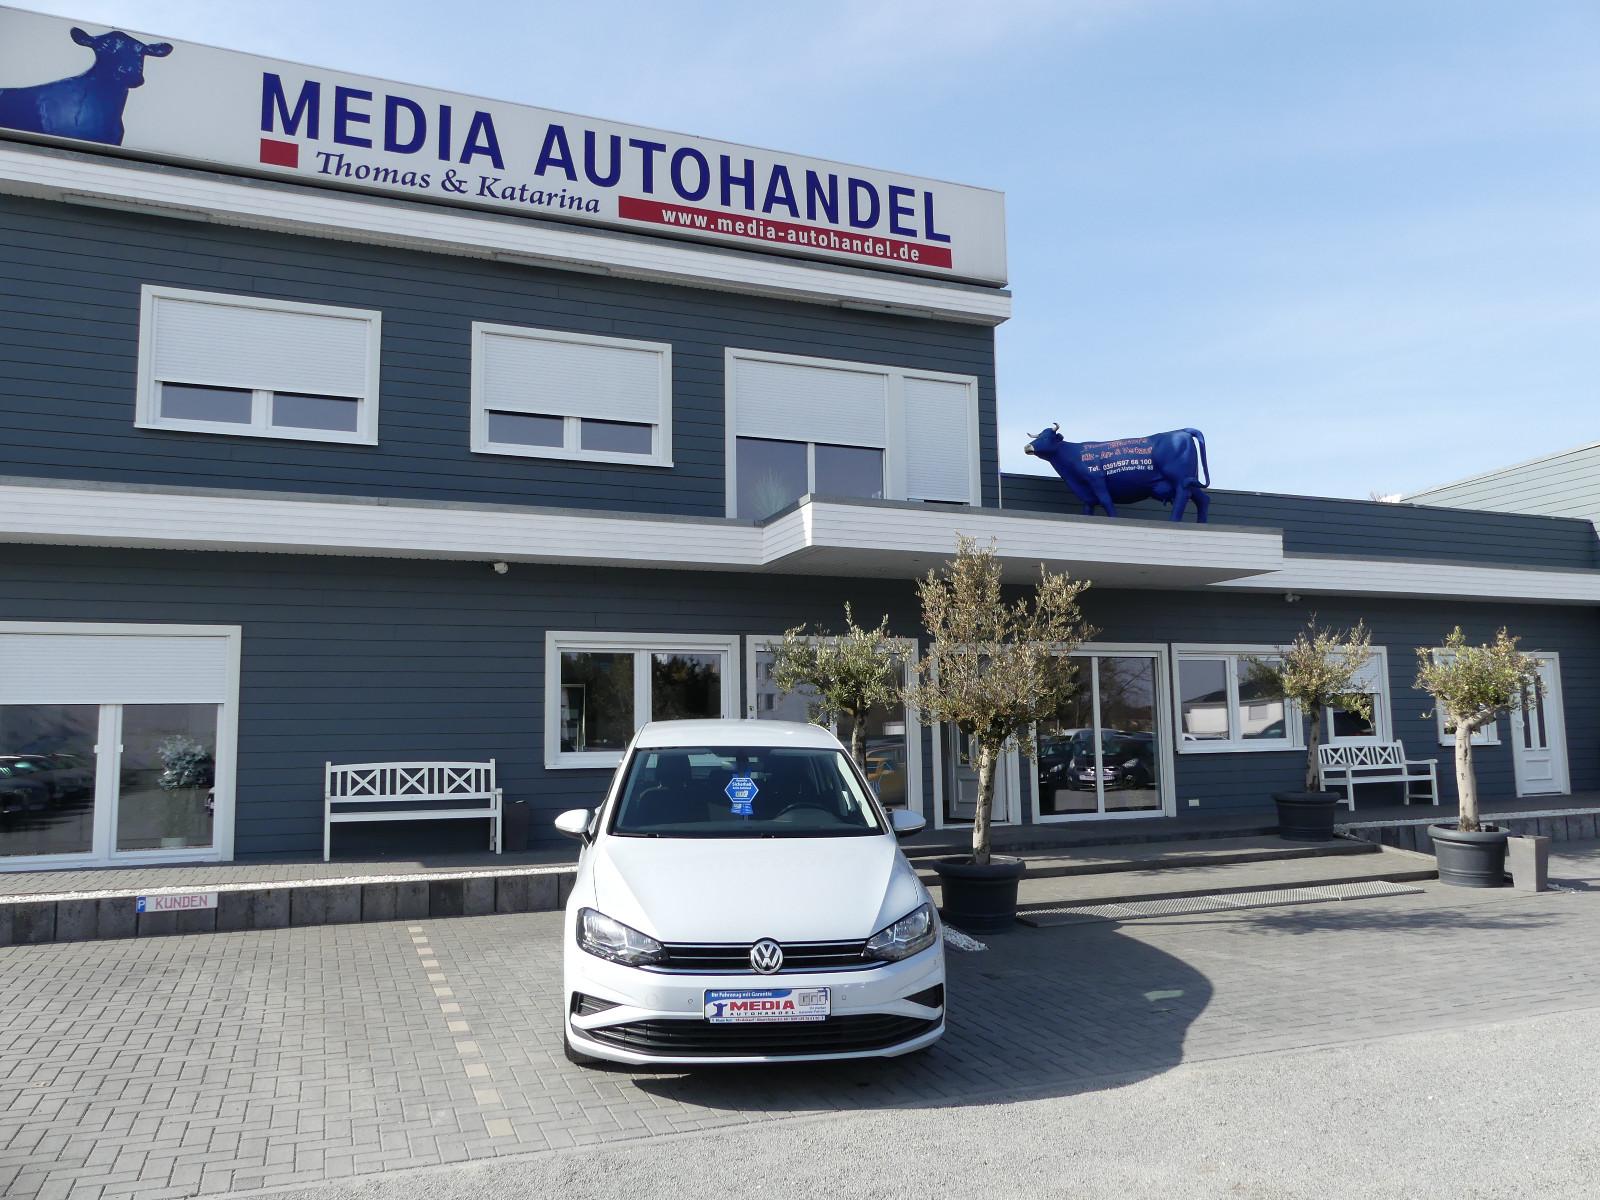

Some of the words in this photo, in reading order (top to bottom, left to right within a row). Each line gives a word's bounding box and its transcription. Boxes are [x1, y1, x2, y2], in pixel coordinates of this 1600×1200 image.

[261, 72, 505, 170] MEDIA
[534, 124, 951, 243] AUTOHANDEL
[316, 151, 431, 188] Thomas
[441, 169, 468, 194] &
[476, 175, 600, 213] Katarina
[662, 209, 919, 262] www.media-autohandel.de
[138, 900, 145, 909] P
[155, 895, 208, 909] KUNDEN
[729, 1000, 795, 1011] MEDIA
